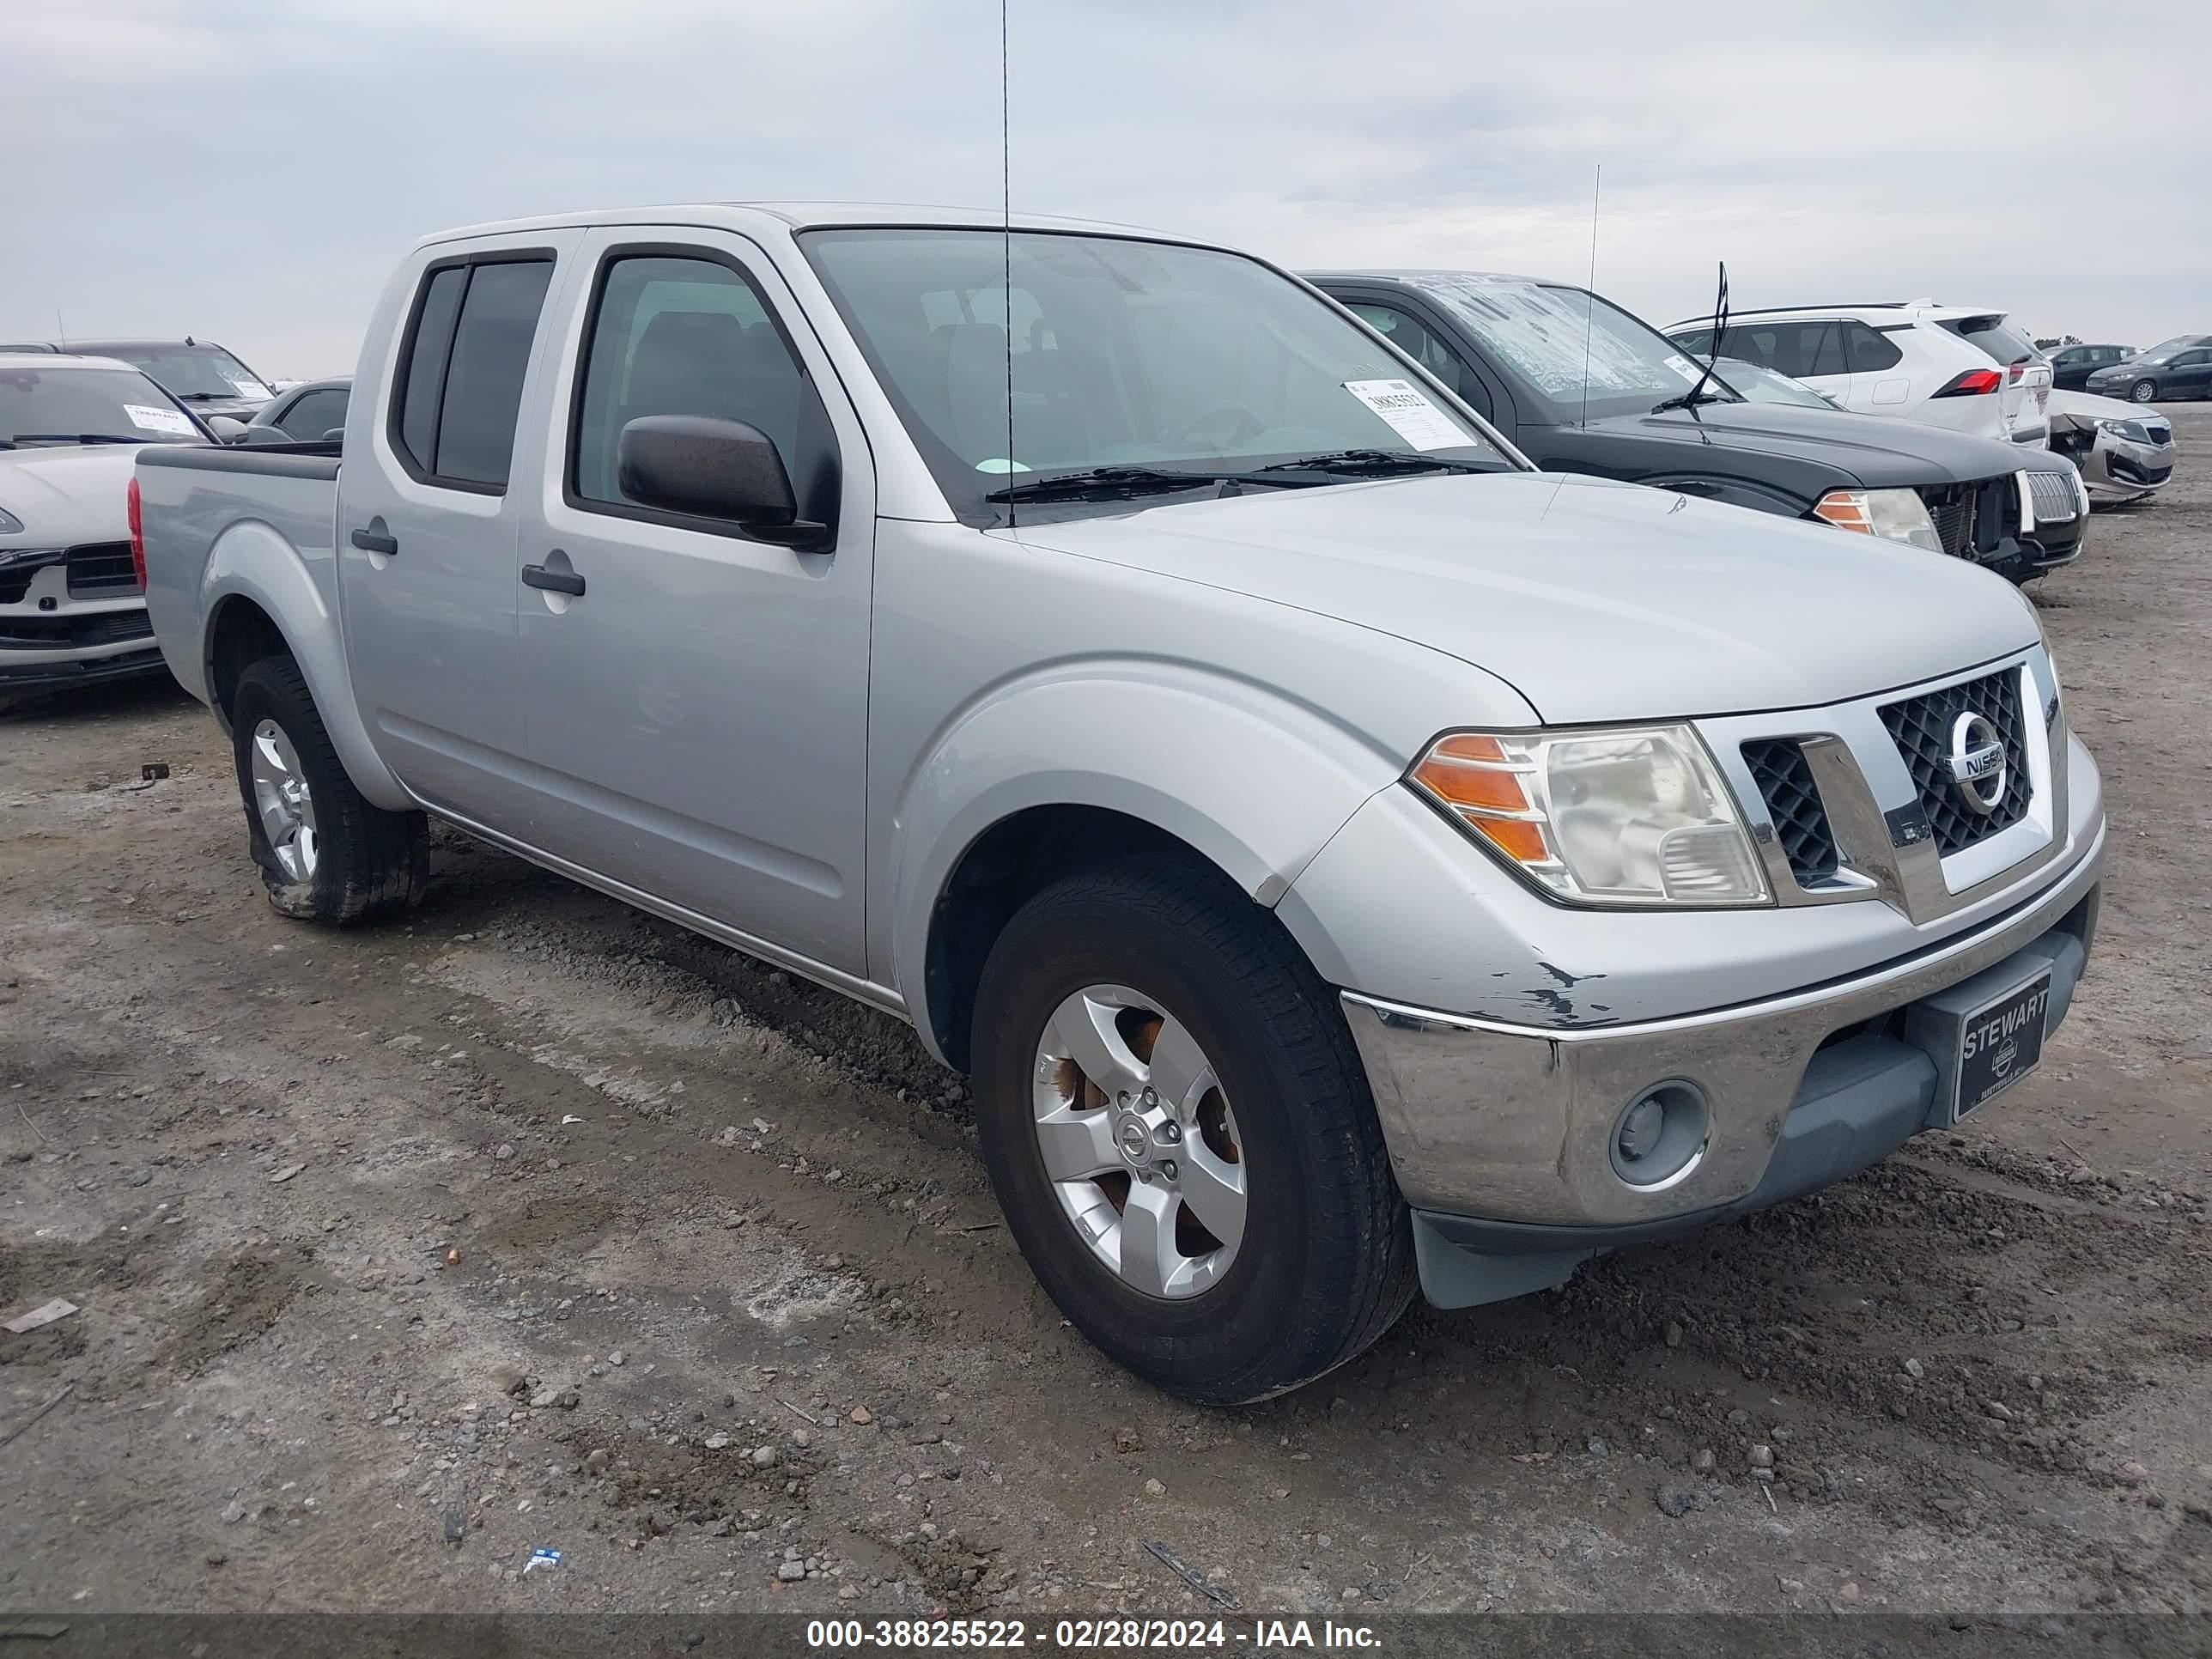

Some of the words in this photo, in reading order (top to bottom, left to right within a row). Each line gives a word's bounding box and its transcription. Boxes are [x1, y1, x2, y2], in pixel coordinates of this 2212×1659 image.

[1367, 394, 1426, 409] 38825522
[1966, 746, 2004, 775] NISSA
[1963, 988, 2049, 1060] STEWART
